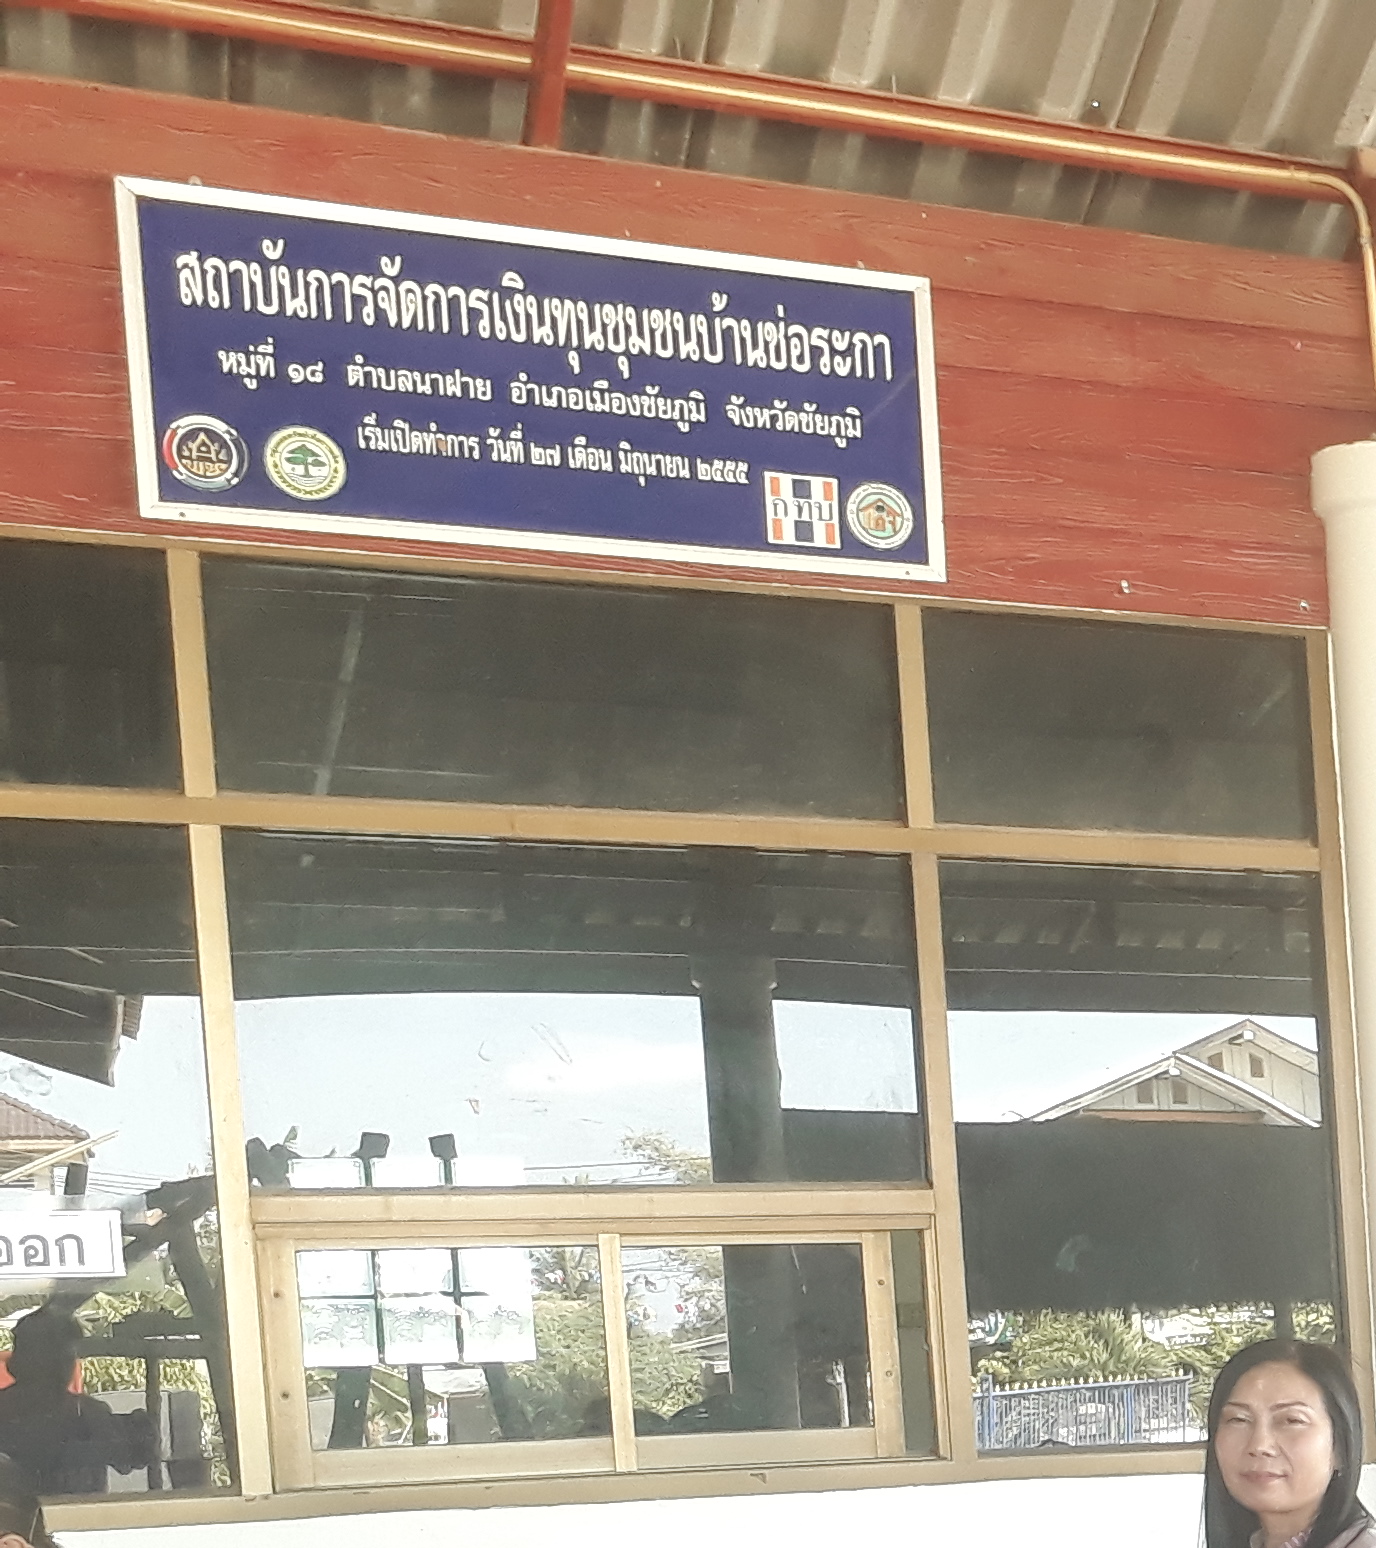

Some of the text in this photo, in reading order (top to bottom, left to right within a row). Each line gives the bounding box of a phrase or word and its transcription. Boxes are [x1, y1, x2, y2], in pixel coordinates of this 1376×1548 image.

[174, 238, 893, 381] สถาบันการจัดการเงินทุนชุมชนบ้านช่อระกา
[217, 336, 863, 448] หมู่ที่ ๑๘ ตำบลนาฝาย อำเภอเมืองชัยภูมิ จังหวัดชัยภูมิ
[486, 422, 525, 465] วันที่
[567, 436, 614, 474] เดือน
[618, 440, 690, 487] มิถุนายน
